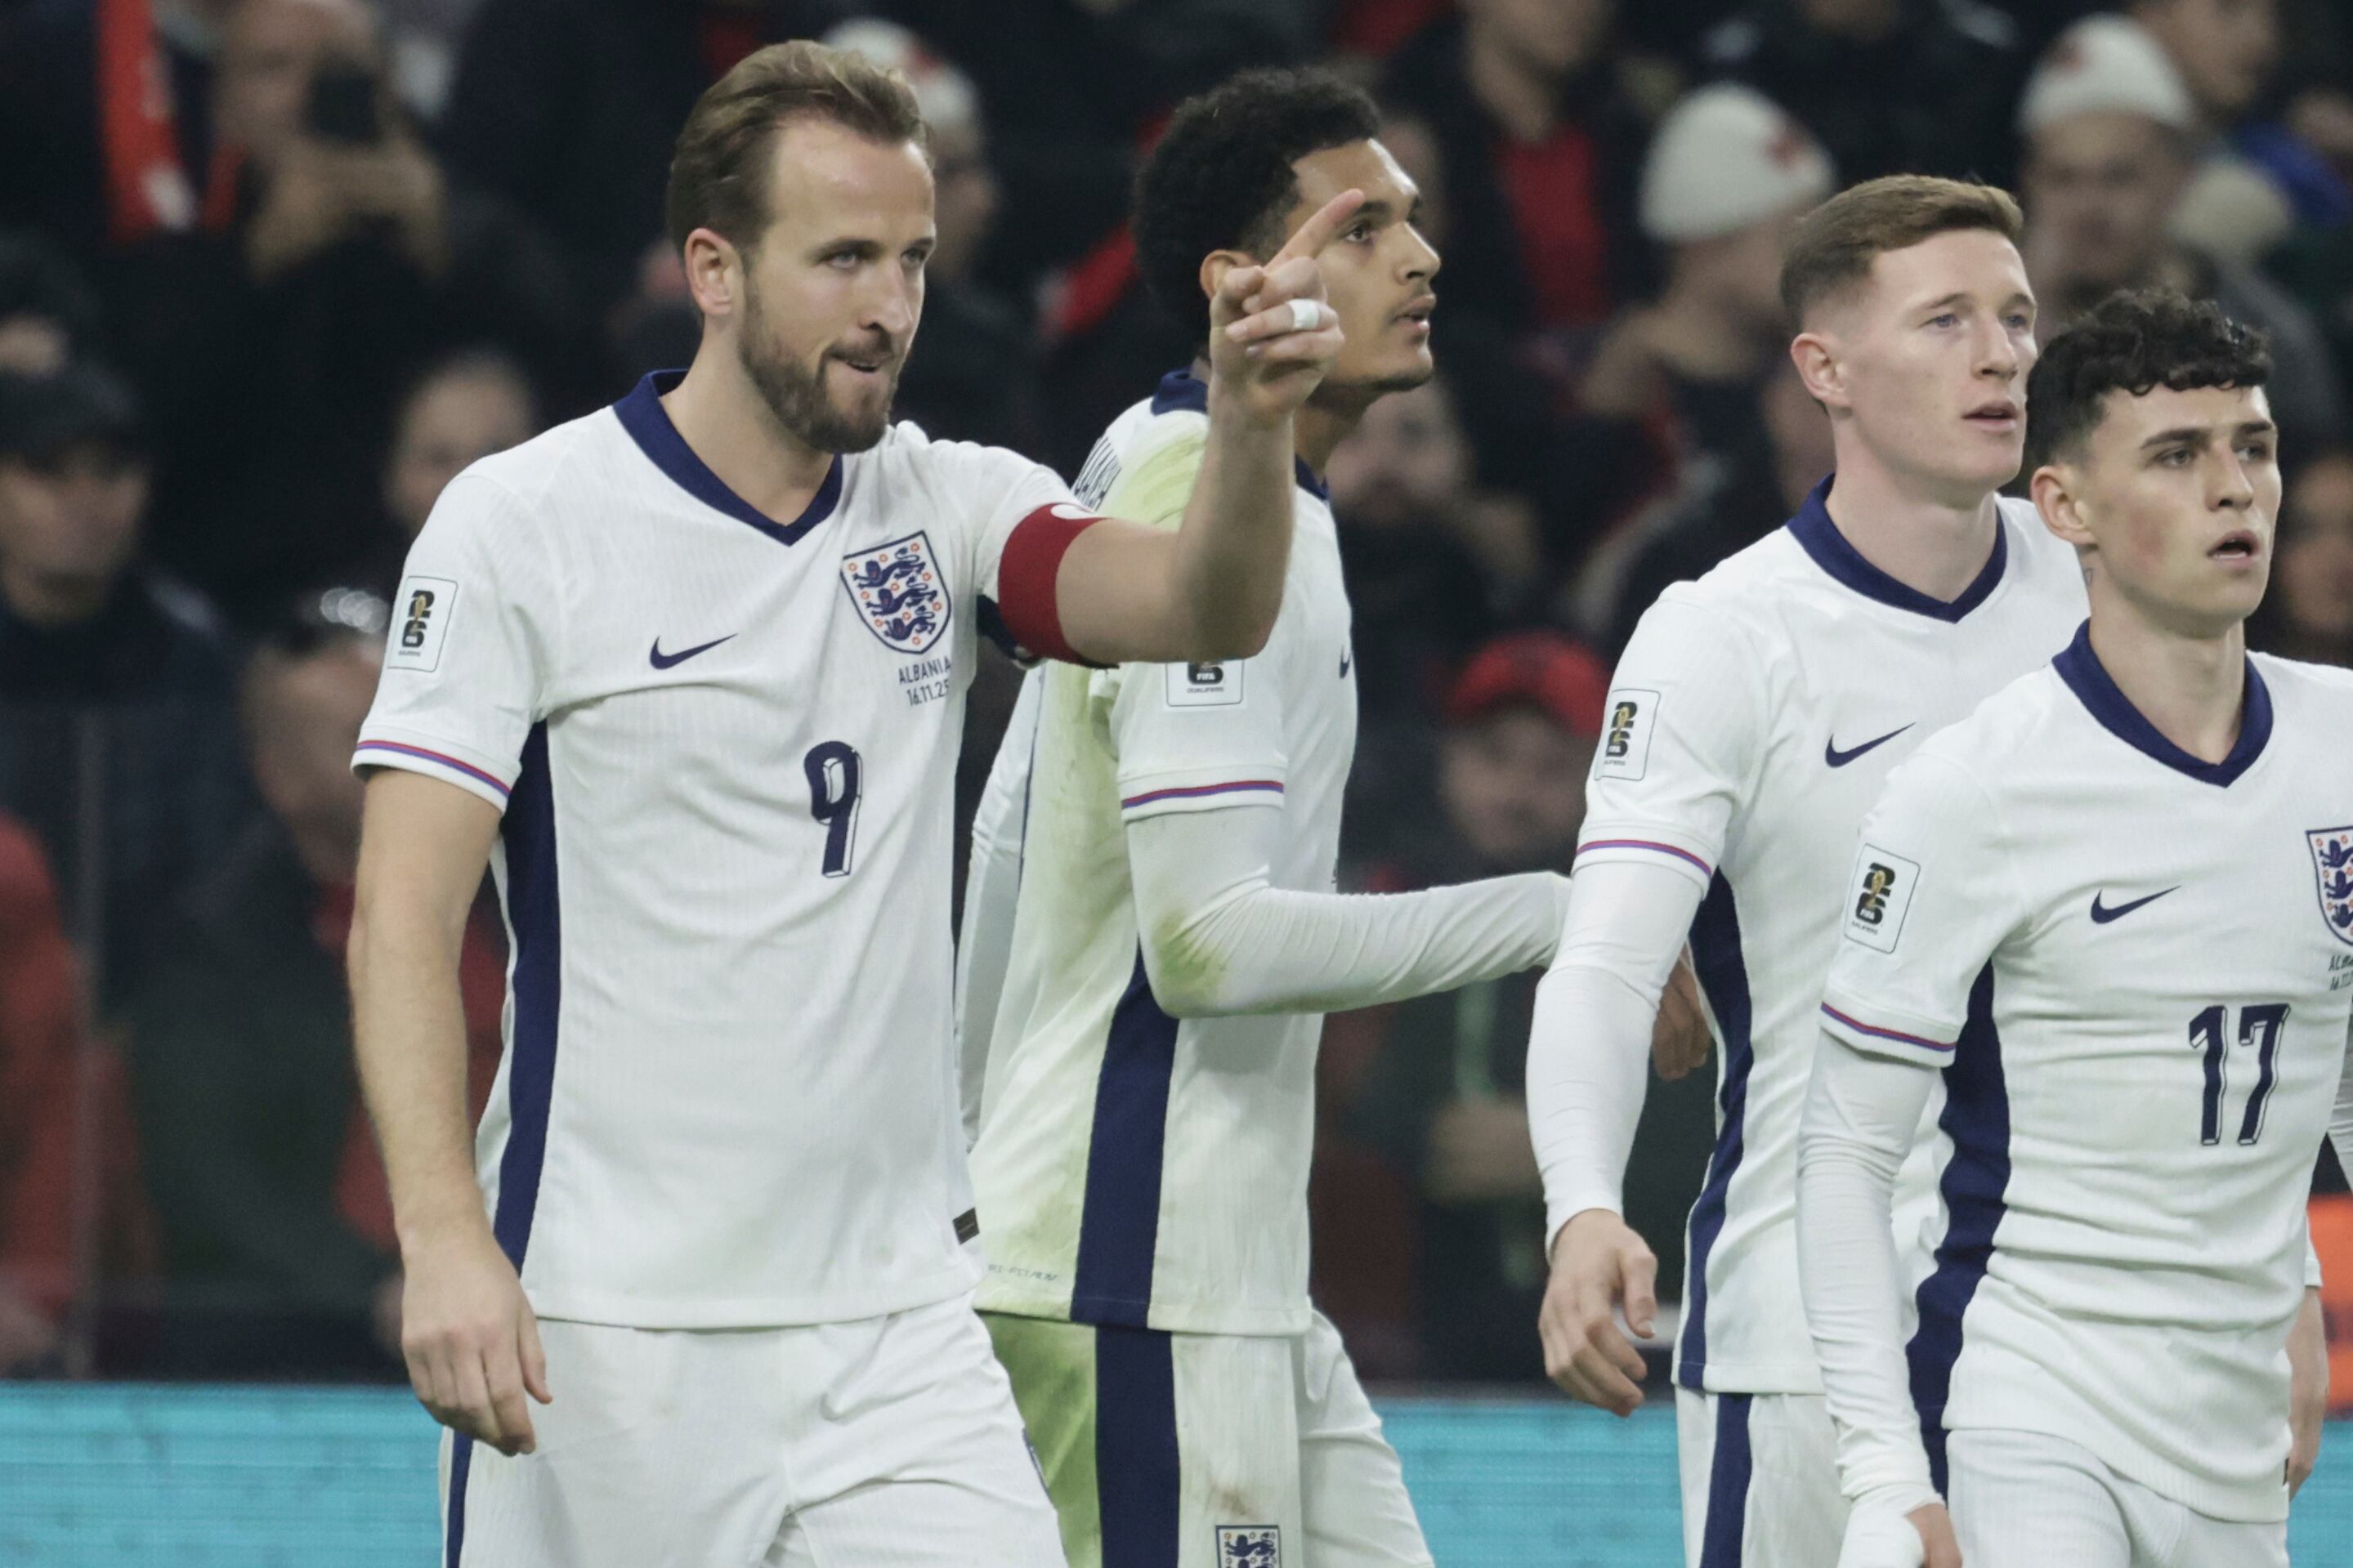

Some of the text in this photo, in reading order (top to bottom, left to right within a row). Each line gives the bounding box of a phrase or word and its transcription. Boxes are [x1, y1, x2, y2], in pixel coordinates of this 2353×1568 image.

[899, 655, 951, 684] ALBANIA
[804, 740, 863, 878] 9
[2189, 1003, 2291, 1146] 17
